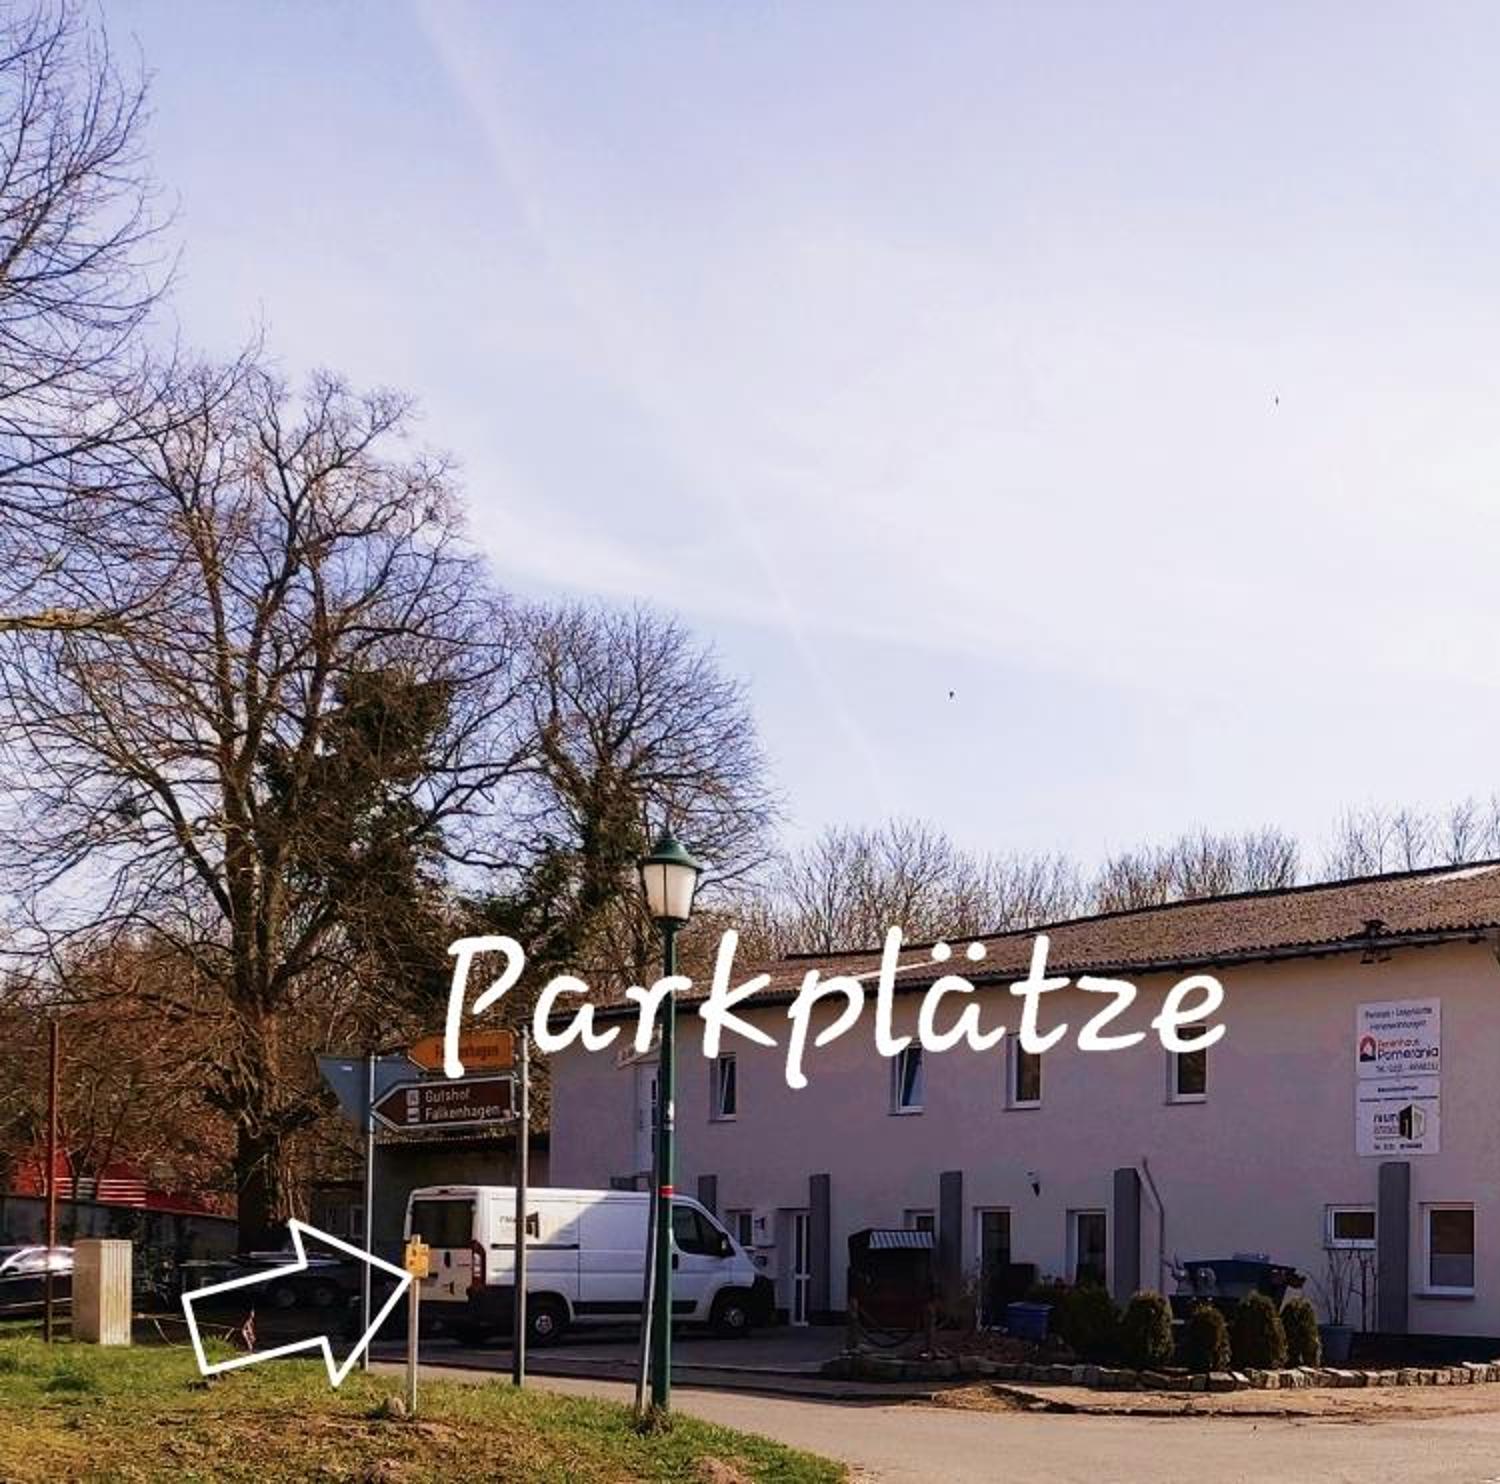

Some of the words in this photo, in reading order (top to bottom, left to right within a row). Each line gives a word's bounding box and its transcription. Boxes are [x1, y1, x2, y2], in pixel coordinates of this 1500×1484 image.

[1377, 1045, 1439, 1061] Pomerania
[424, 1087, 471, 1103] Gutshof
[424, 1104, 501, 1121] Falkenhagen
